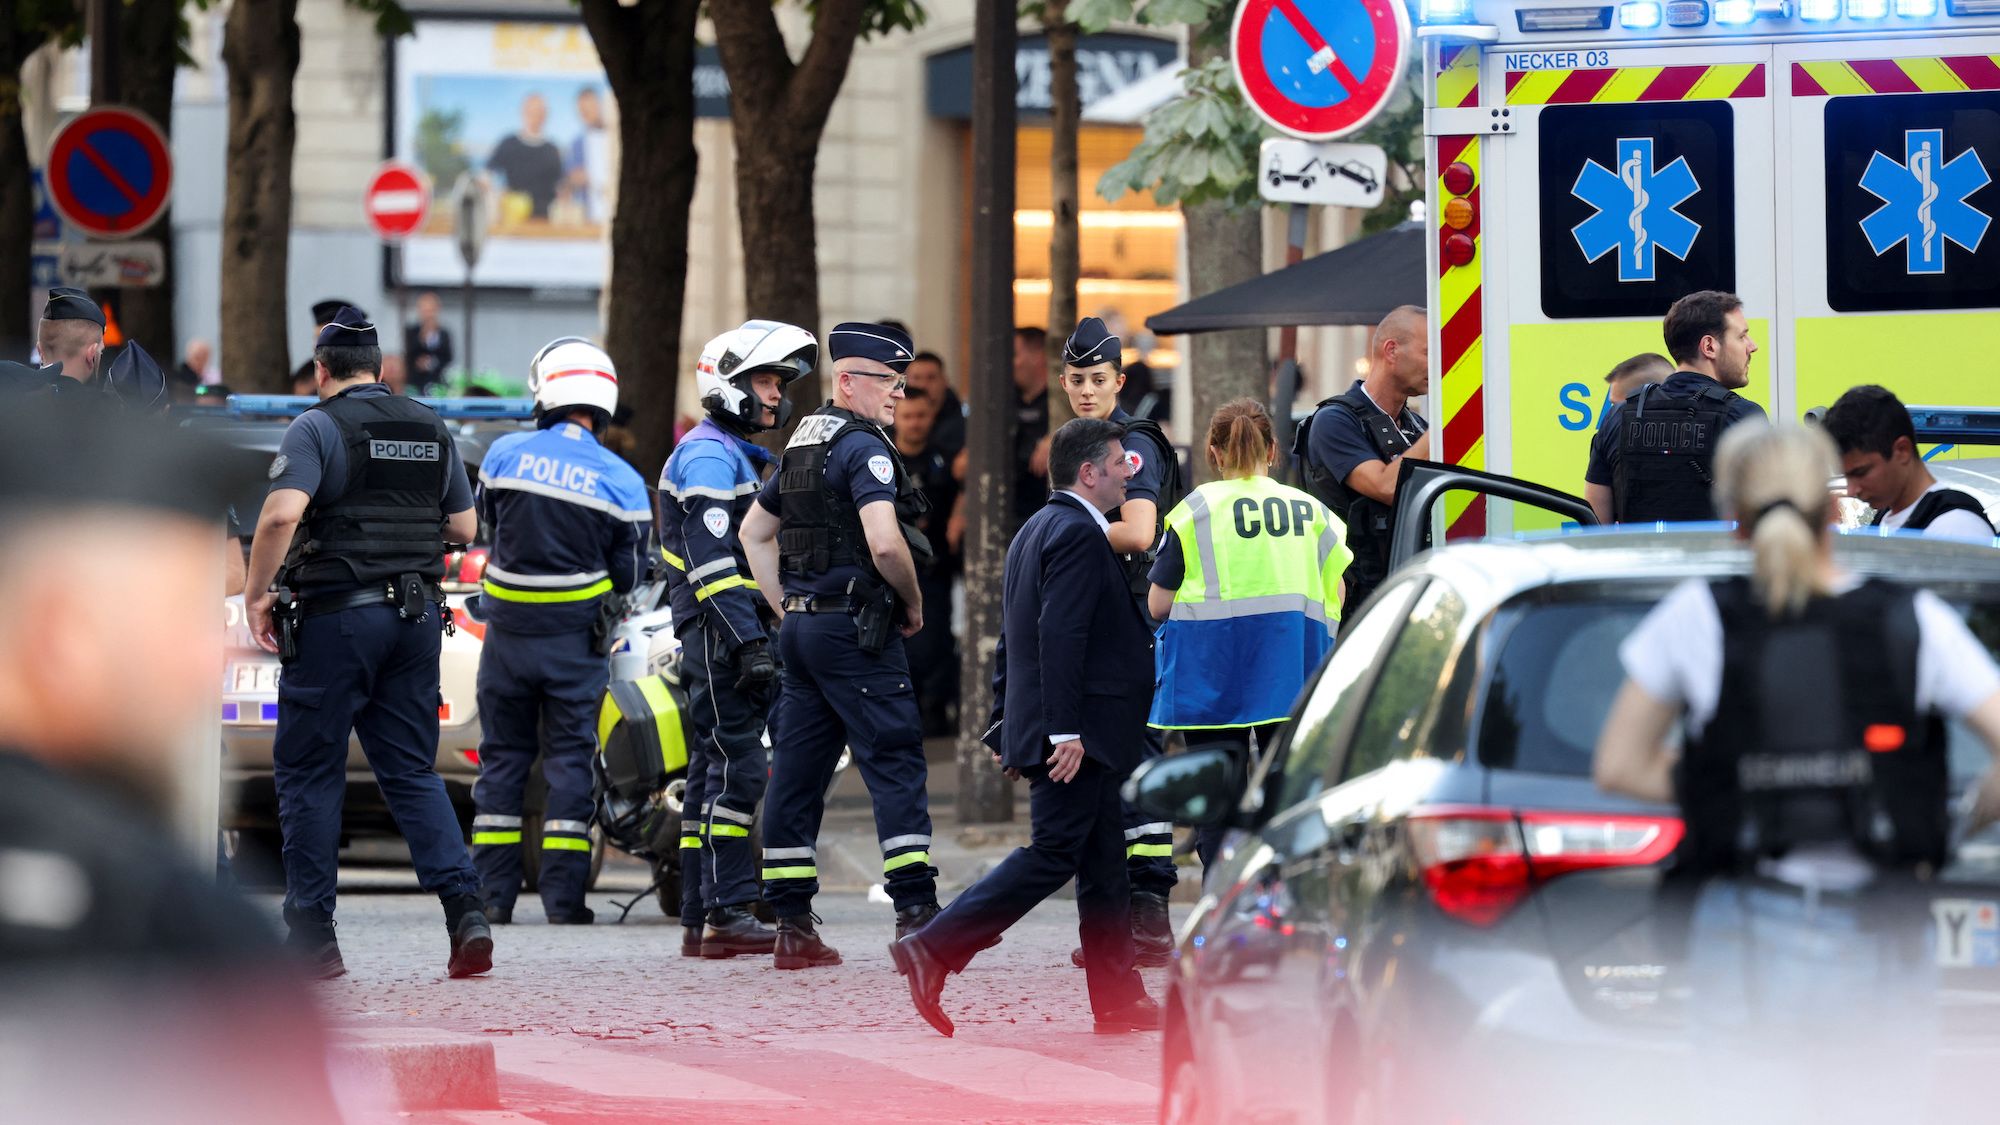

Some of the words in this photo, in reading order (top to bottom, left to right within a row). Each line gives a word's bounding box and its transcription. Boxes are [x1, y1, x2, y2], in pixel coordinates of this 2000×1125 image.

[1506, 53, 1578, 69] NECKER
[1586, 51, 1609, 67] 03
[1628, 421, 1706, 448] POLICE
[375, 443, 434, 459] POLICE
[516, 453, 600, 496] POLICE
[1233, 497, 1314, 539] COP
